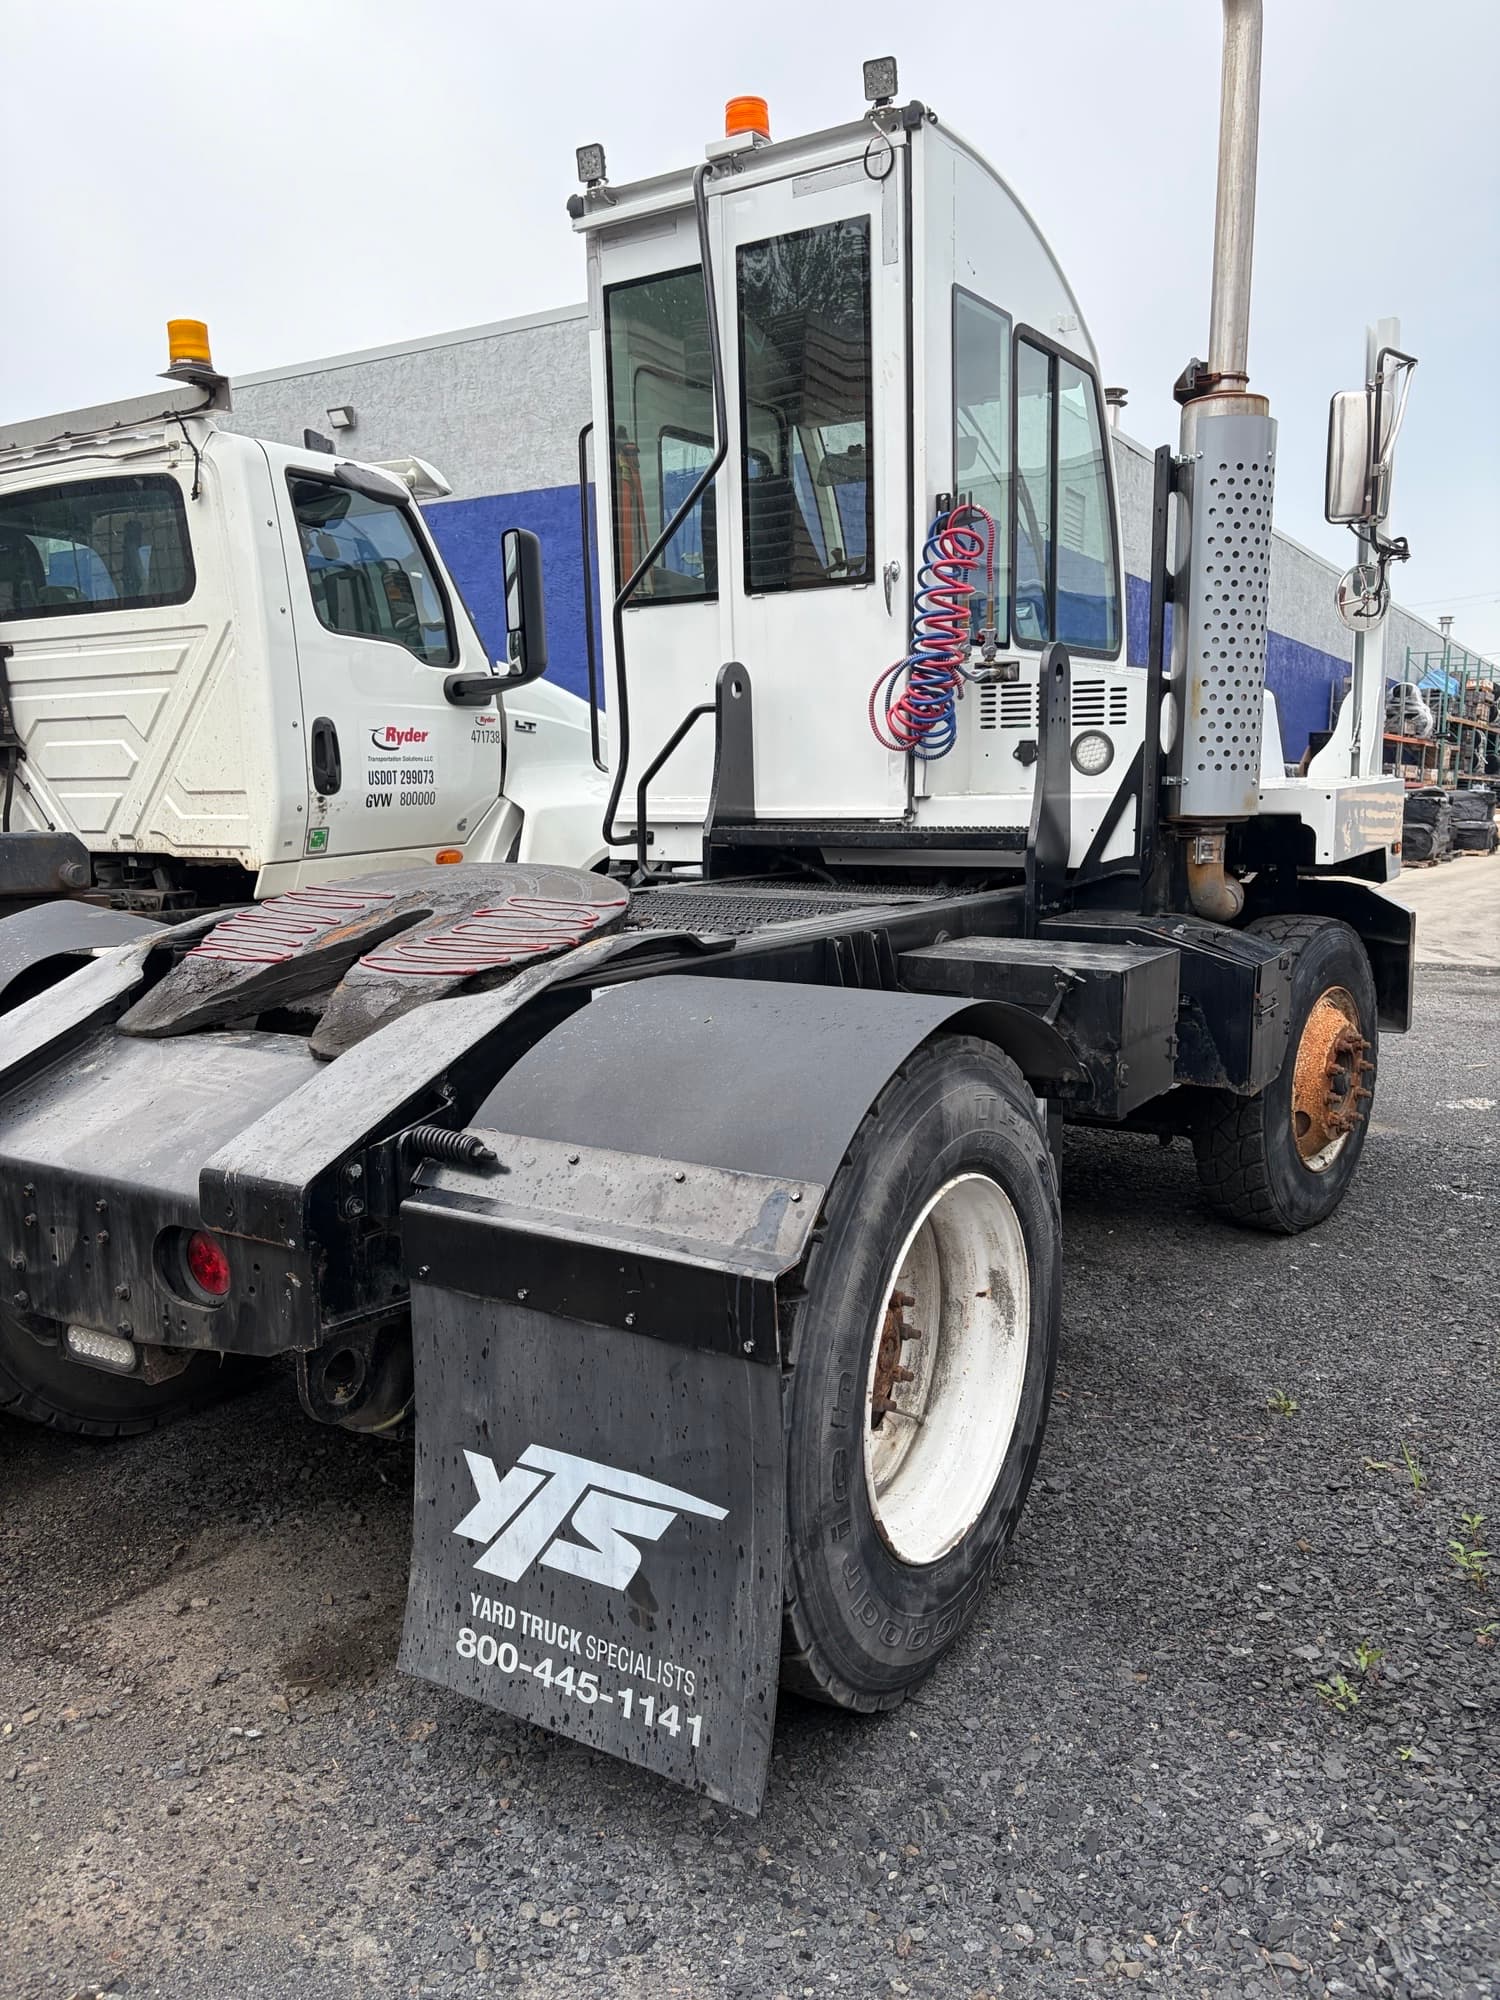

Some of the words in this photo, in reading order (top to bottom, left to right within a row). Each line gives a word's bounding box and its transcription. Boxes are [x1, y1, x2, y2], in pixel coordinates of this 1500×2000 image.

[480, 716, 496, 724] Ryder
[515, 720, 536, 730] LT
[385, 726, 429, 745] Ryder
[471, 730, 500, 744] 471738
[368, 770, 397, 785] USDOT
[400, 770, 434, 785] 299073
[366, 793, 392, 808] GVW
[400, 791, 435, 806] 800000
[452, 1444, 730, 1592] YTS
[470, 1591, 516, 1630] YARD
[519, 1610, 583, 1655] TRUCK
[585, 1635, 696, 1697] SPECIALISTS
[456, 1627, 703, 1748] 800-445-1141
